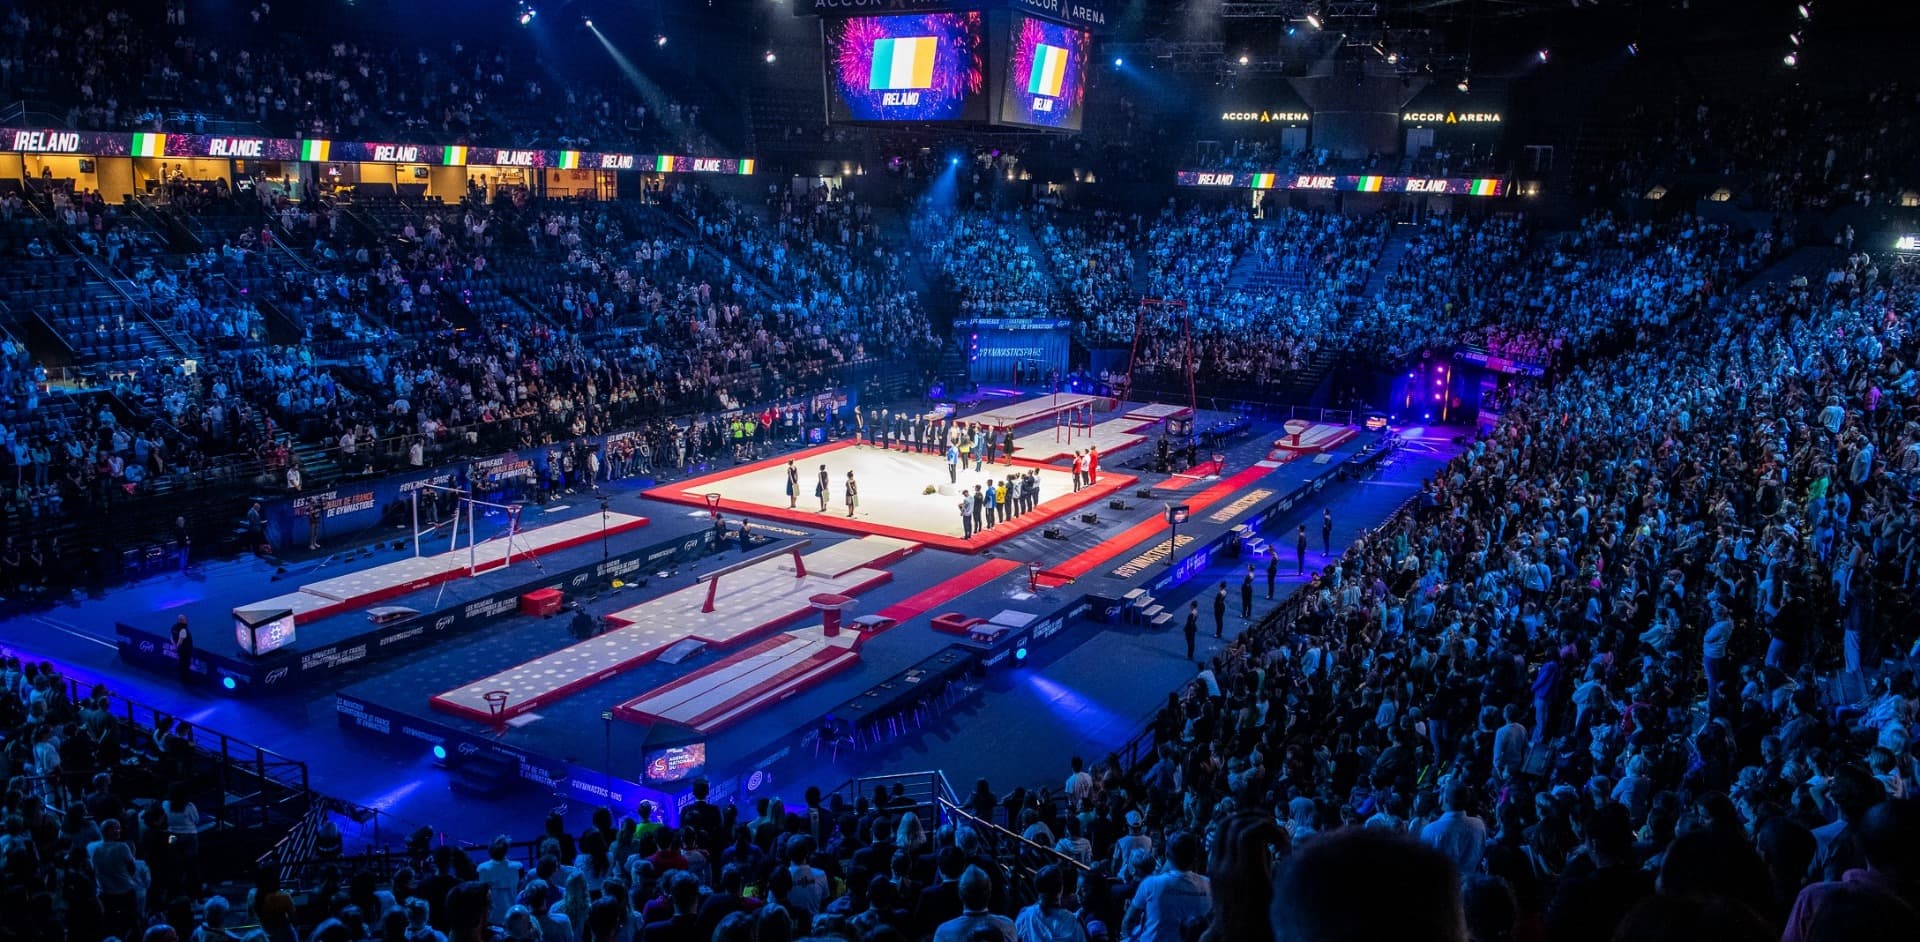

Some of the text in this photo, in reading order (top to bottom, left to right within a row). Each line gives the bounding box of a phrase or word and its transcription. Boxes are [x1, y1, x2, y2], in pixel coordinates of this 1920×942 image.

[1072, 4, 1105, 25] ARENA
[882, 92, 919, 106] IRELAND
[1222, 112, 1309, 121] ACCOR ARENA
[1403, 113, 1501, 123] ACCOR ARENA
[13, 130, 80, 153] IRELAND
[210, 138, 263, 157] IRLANDE
[374, 145, 418, 162] IRELAND
[496, 150, 533, 166] IRLANDE
[602, 154, 633, 169] IRELAND
[693, 158, 721, 172] IRLANDE
[1197, 173, 1234, 187] IRELAND
[1296, 175, 1335, 190] IRLANDE
[1405, 178, 1447, 192] IRELAND
